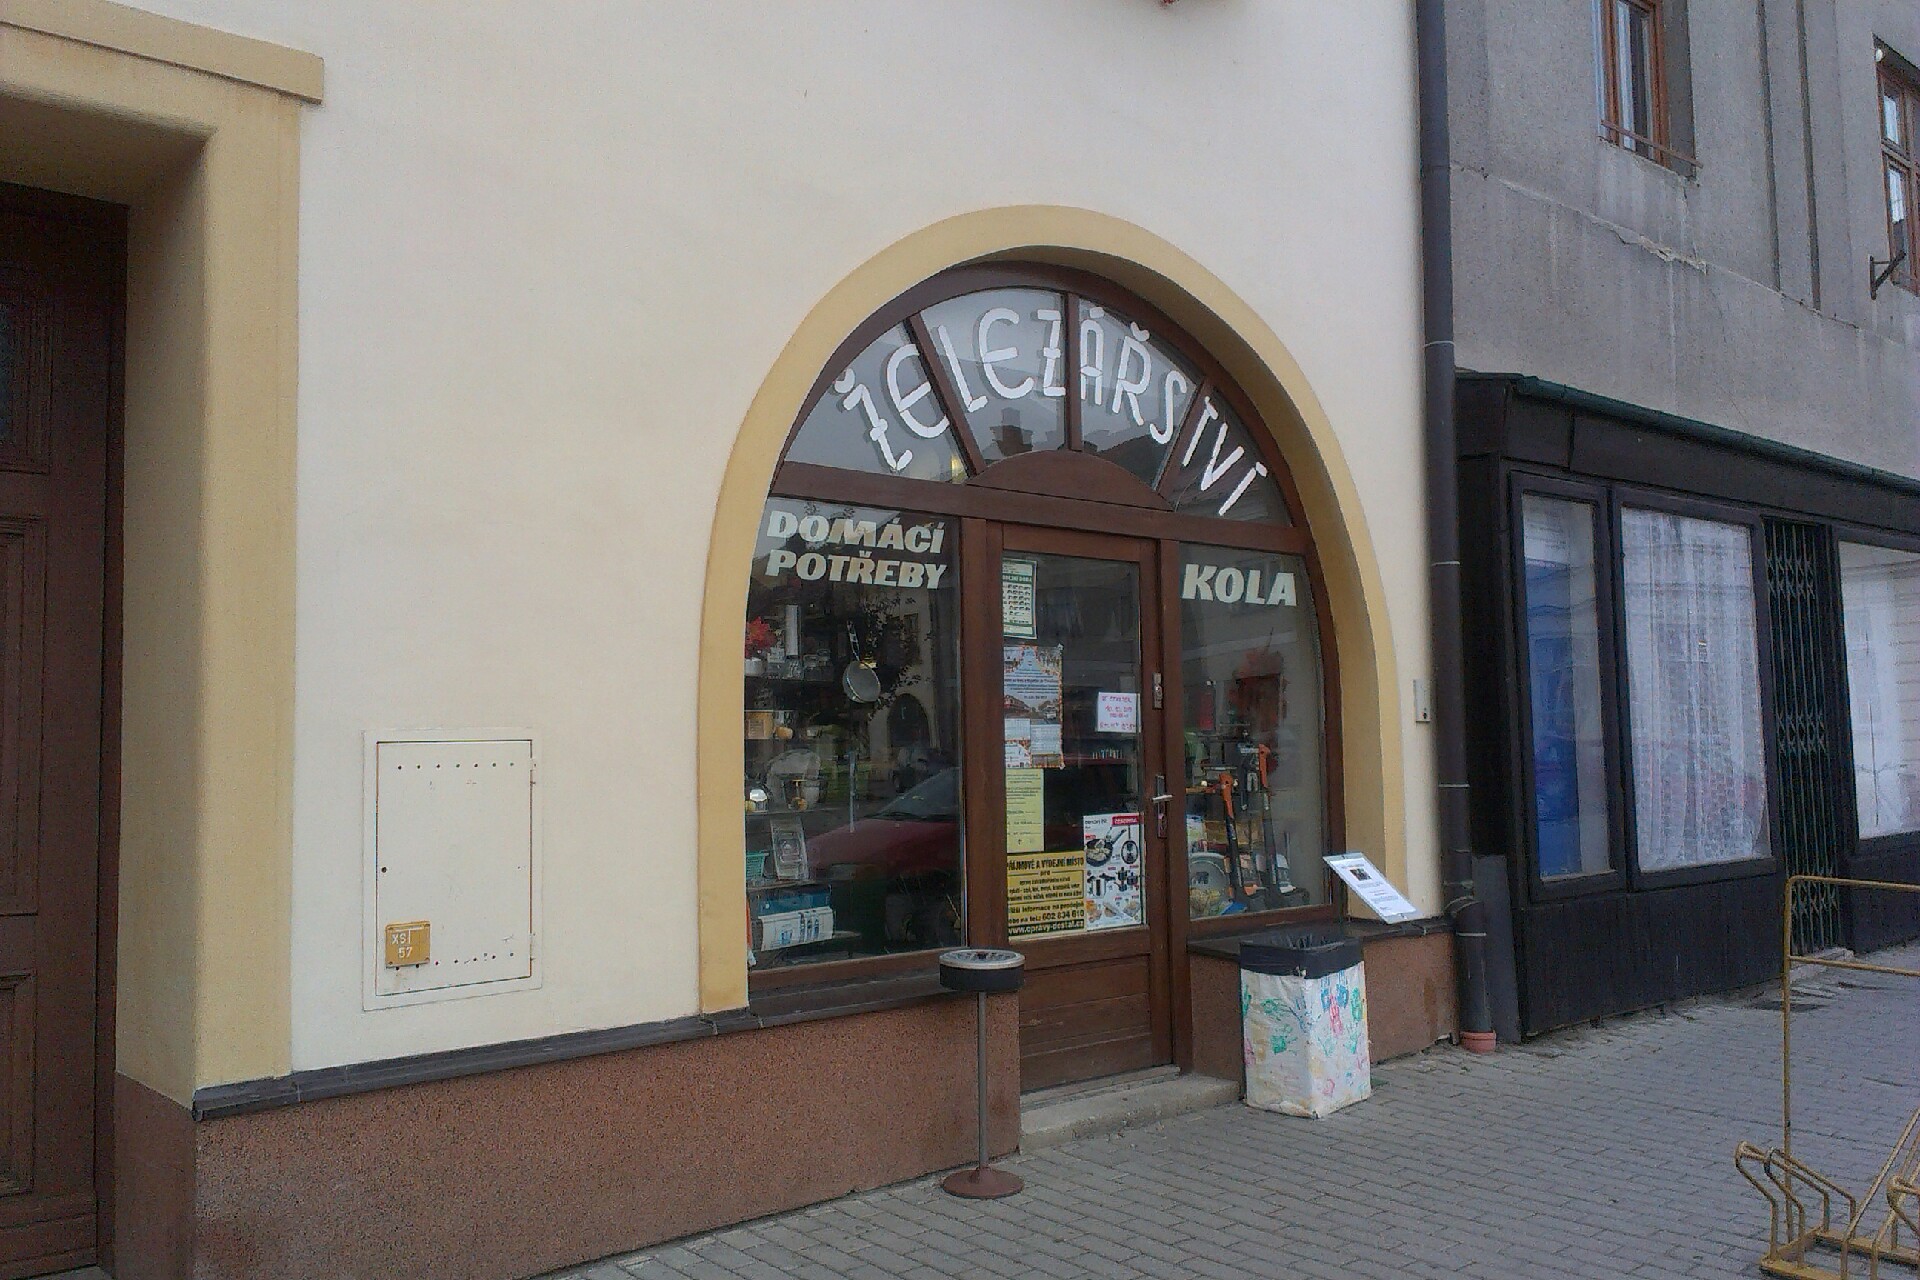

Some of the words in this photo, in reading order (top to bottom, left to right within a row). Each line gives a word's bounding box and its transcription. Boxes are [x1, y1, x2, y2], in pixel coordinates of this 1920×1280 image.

[767, 510, 945, 553] DOMÁCÍ
[765, 550, 947, 589] POTŘEBY
[1182, 564, 1297, 606] KOLA
[398, 946, 413, 958] 57
